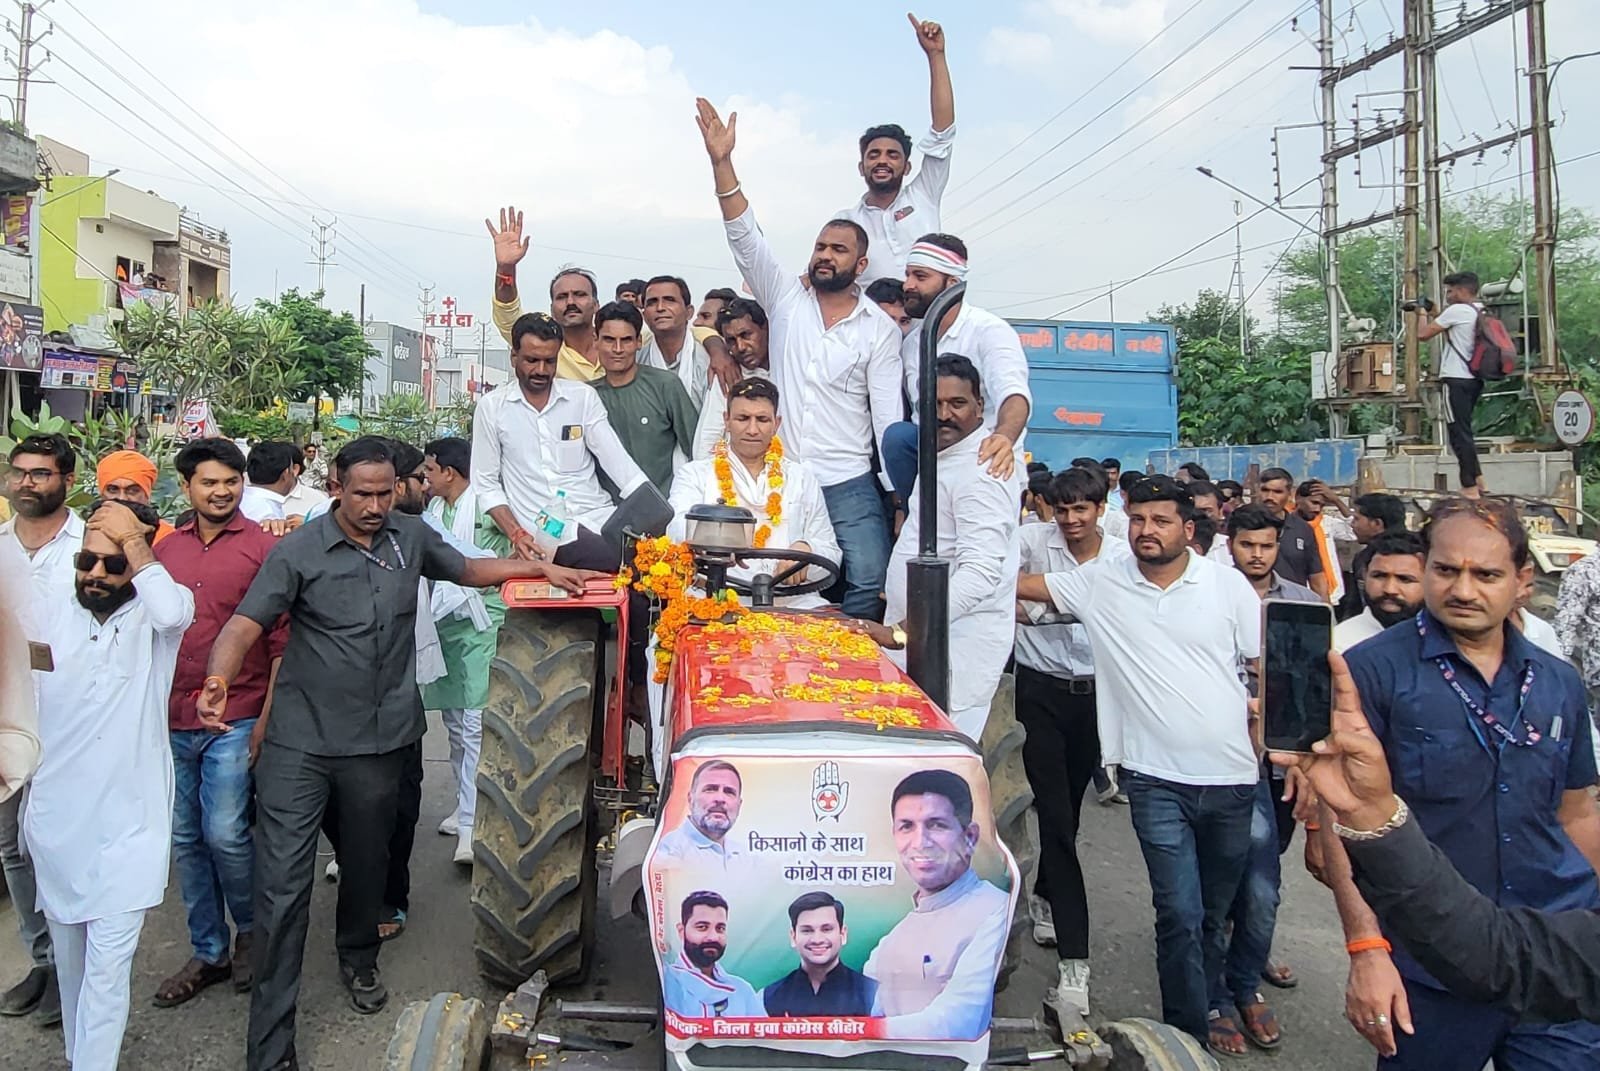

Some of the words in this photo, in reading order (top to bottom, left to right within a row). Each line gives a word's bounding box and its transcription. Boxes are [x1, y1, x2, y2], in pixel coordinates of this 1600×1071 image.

[425, 310, 473, 328] नर्मदा
[1564, 411, 1579, 427] 20
[749, 831, 807, 852] किसानो
[811, 831, 827, 852] के
[830, 837, 864, 852] साथ
[784, 860, 833, 882] कांग्रेस
[837, 865, 858, 881] का
[861, 865, 894, 882] हाथ
[713, 1019, 750, 1035] जिला
[753, 1021, 780, 1038] युवा
[783, 1018, 824, 1035] कांग्रेस
[827, 1018, 866, 1035] सीहोर
